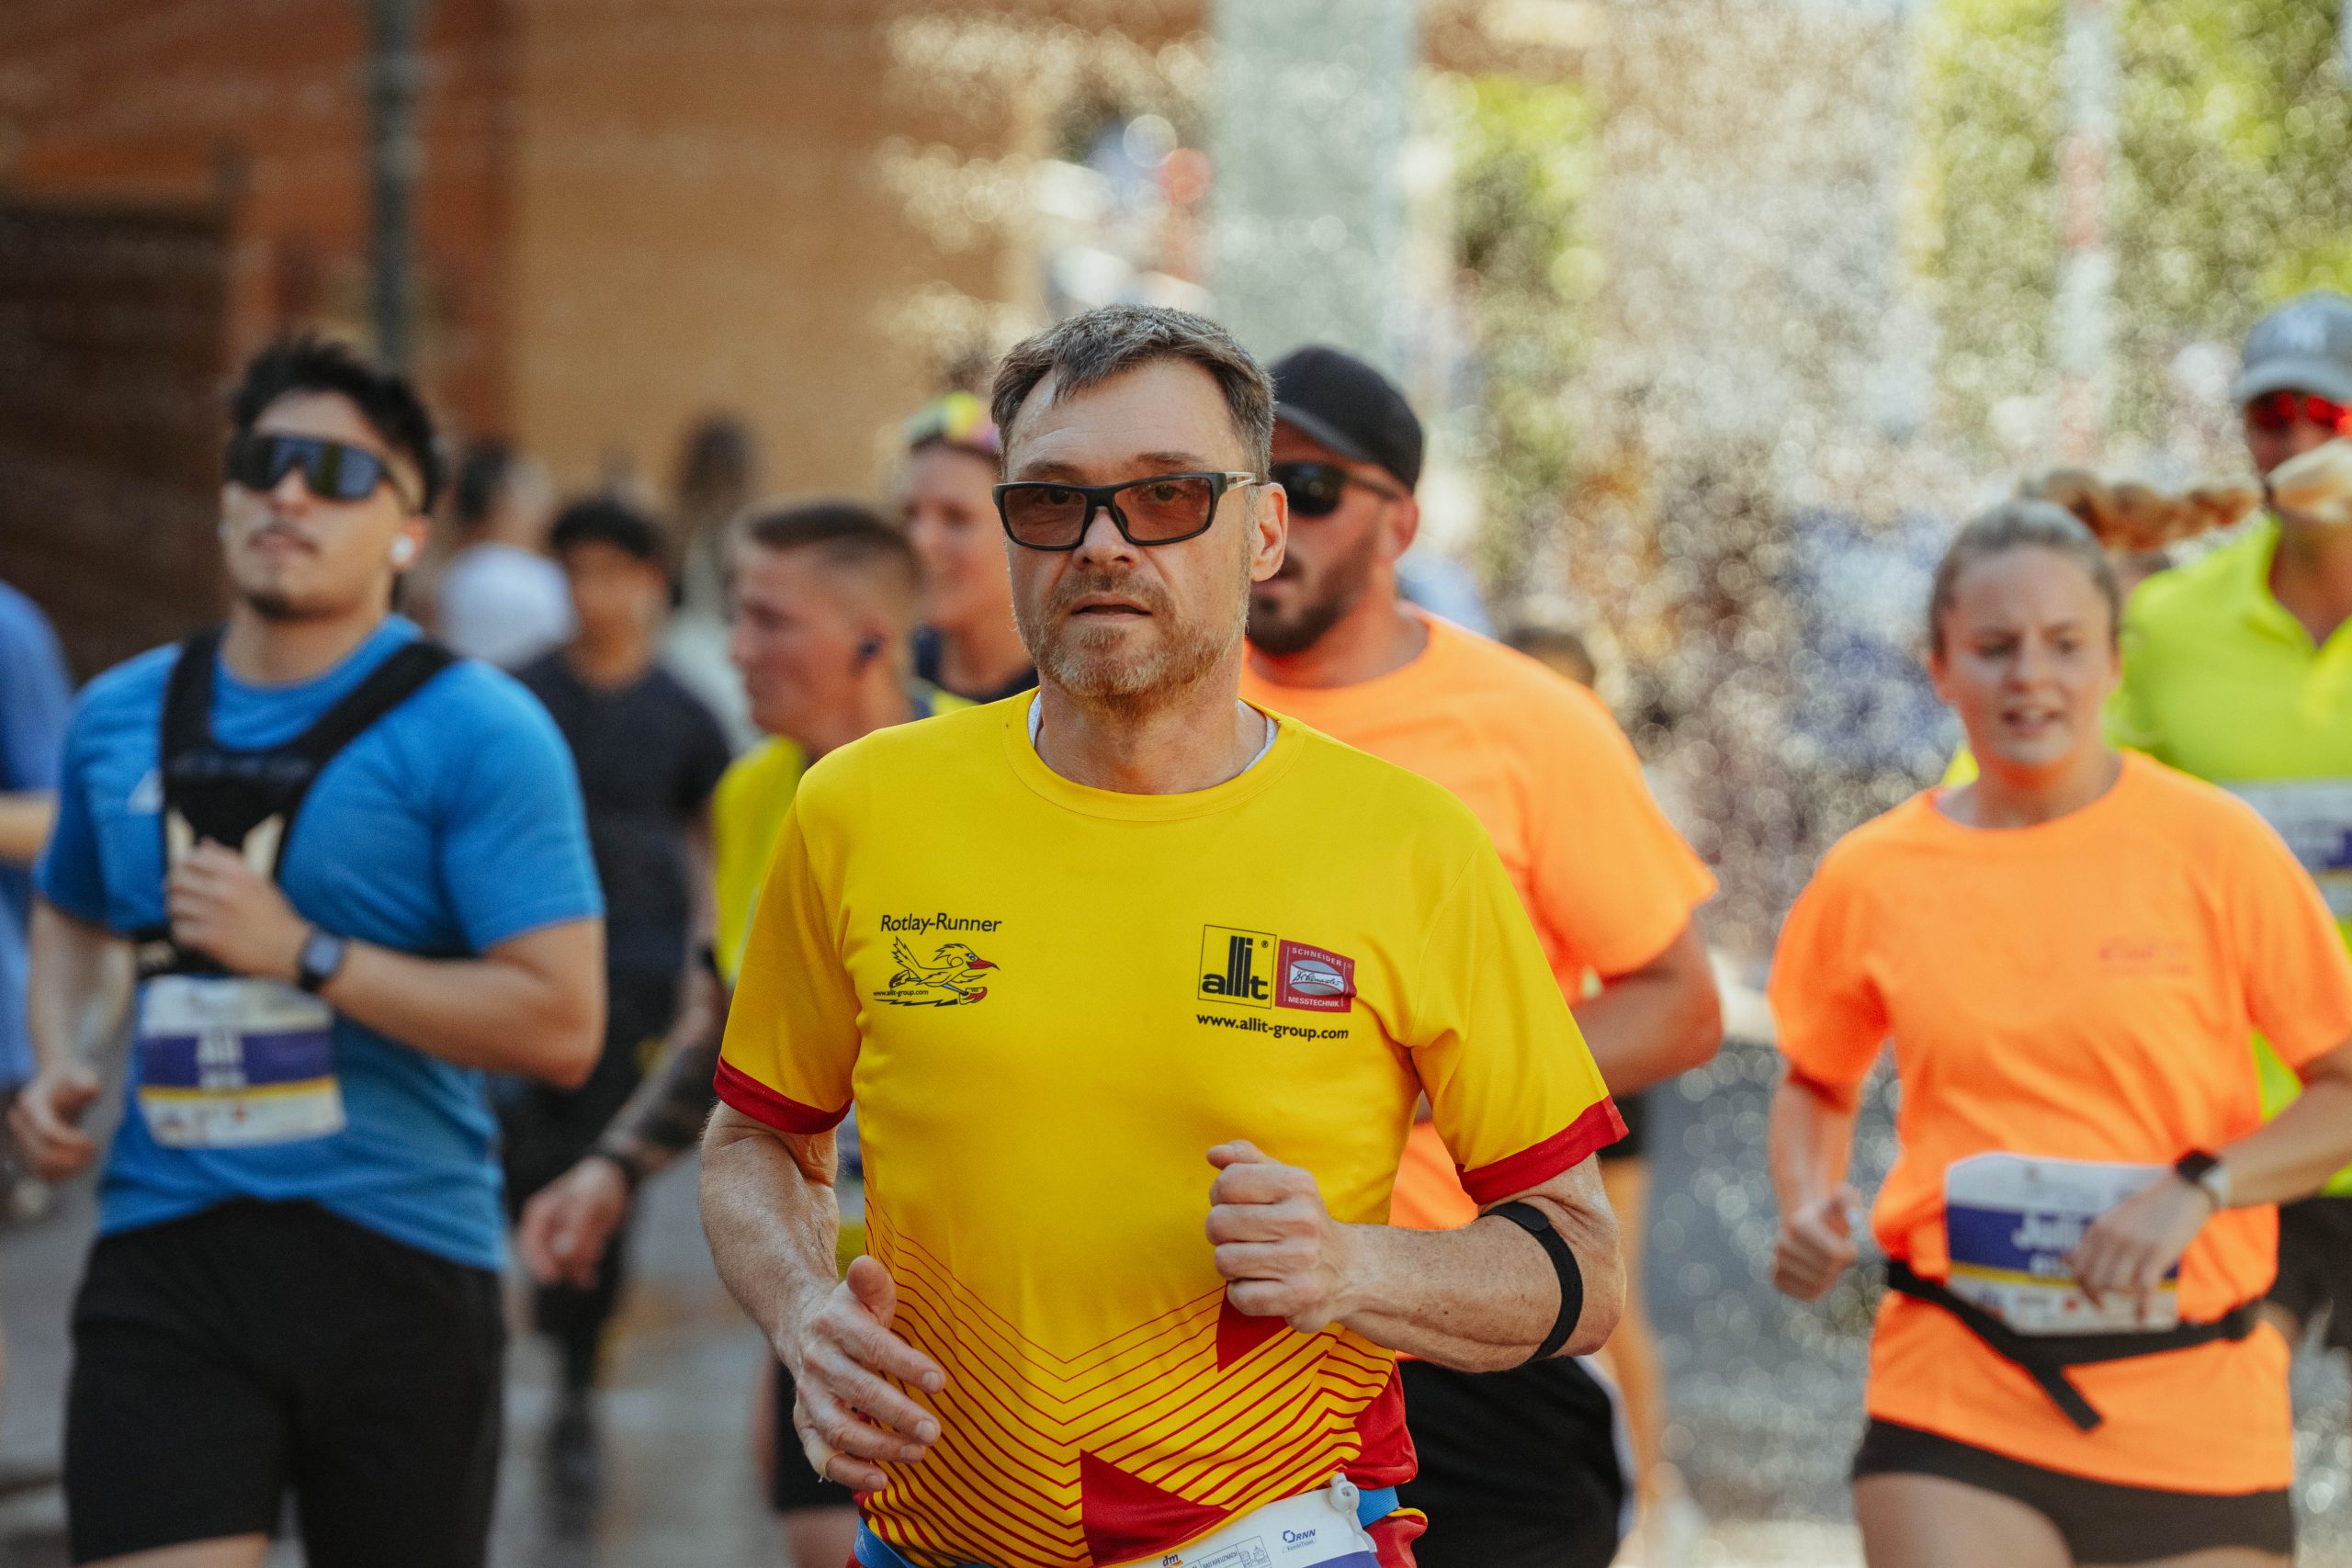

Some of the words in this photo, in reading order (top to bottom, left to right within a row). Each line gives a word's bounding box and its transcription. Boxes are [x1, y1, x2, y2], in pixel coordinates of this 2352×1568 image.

[880, 912, 1002, 935] Rotlay-Runner
[1292, 947, 1342, 966] SCHNEIDER
[1202, 935, 1269, 1000] allit
[1288, 996, 1340, 1008] MESSTECHNIK
[1196, 1013, 1349, 1042] www.allit-group.com
[1162, 1554, 1179, 1566] dm
